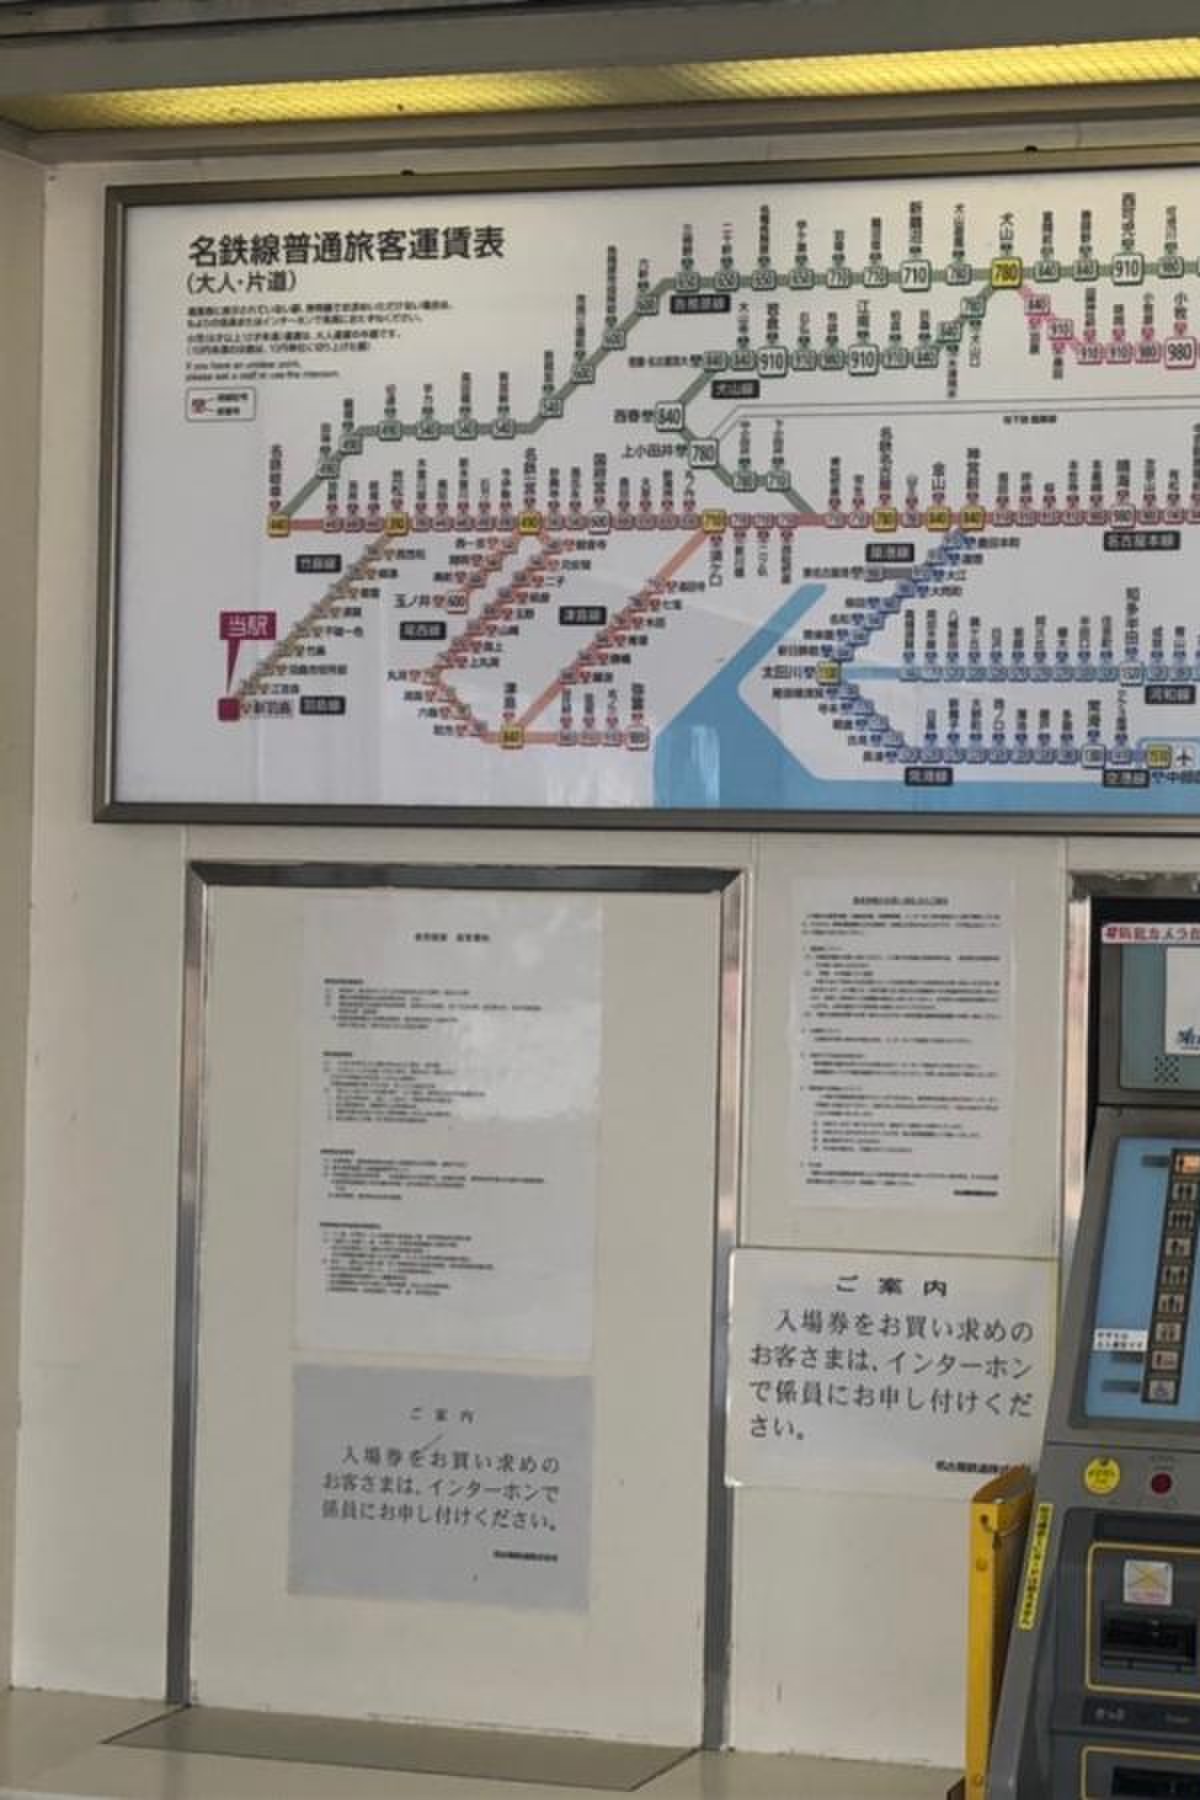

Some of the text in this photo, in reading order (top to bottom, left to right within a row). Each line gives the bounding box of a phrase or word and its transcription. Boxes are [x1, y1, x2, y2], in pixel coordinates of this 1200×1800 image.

[188, 225, 505, 267] 名鉄線普通旅客運賃表
[186, 270, 298, 295] (大人・片道)
[774, 1308, 1034, 1343] 入場券をお買い求めの
[749, 1344, 1033, 1380] お客さまは、インターホン
[750, 1380, 1033, 1418] で係員にお申し付けくだ
[750, 1413, 804, 1441] さい。
[341, 1445, 561, 1475] 入場券をお買い求めの
[321, 1472, 561, 1504] お客さまは、インターホンで
[321, 1498, 557, 1532] 係員にお申し付けください。
